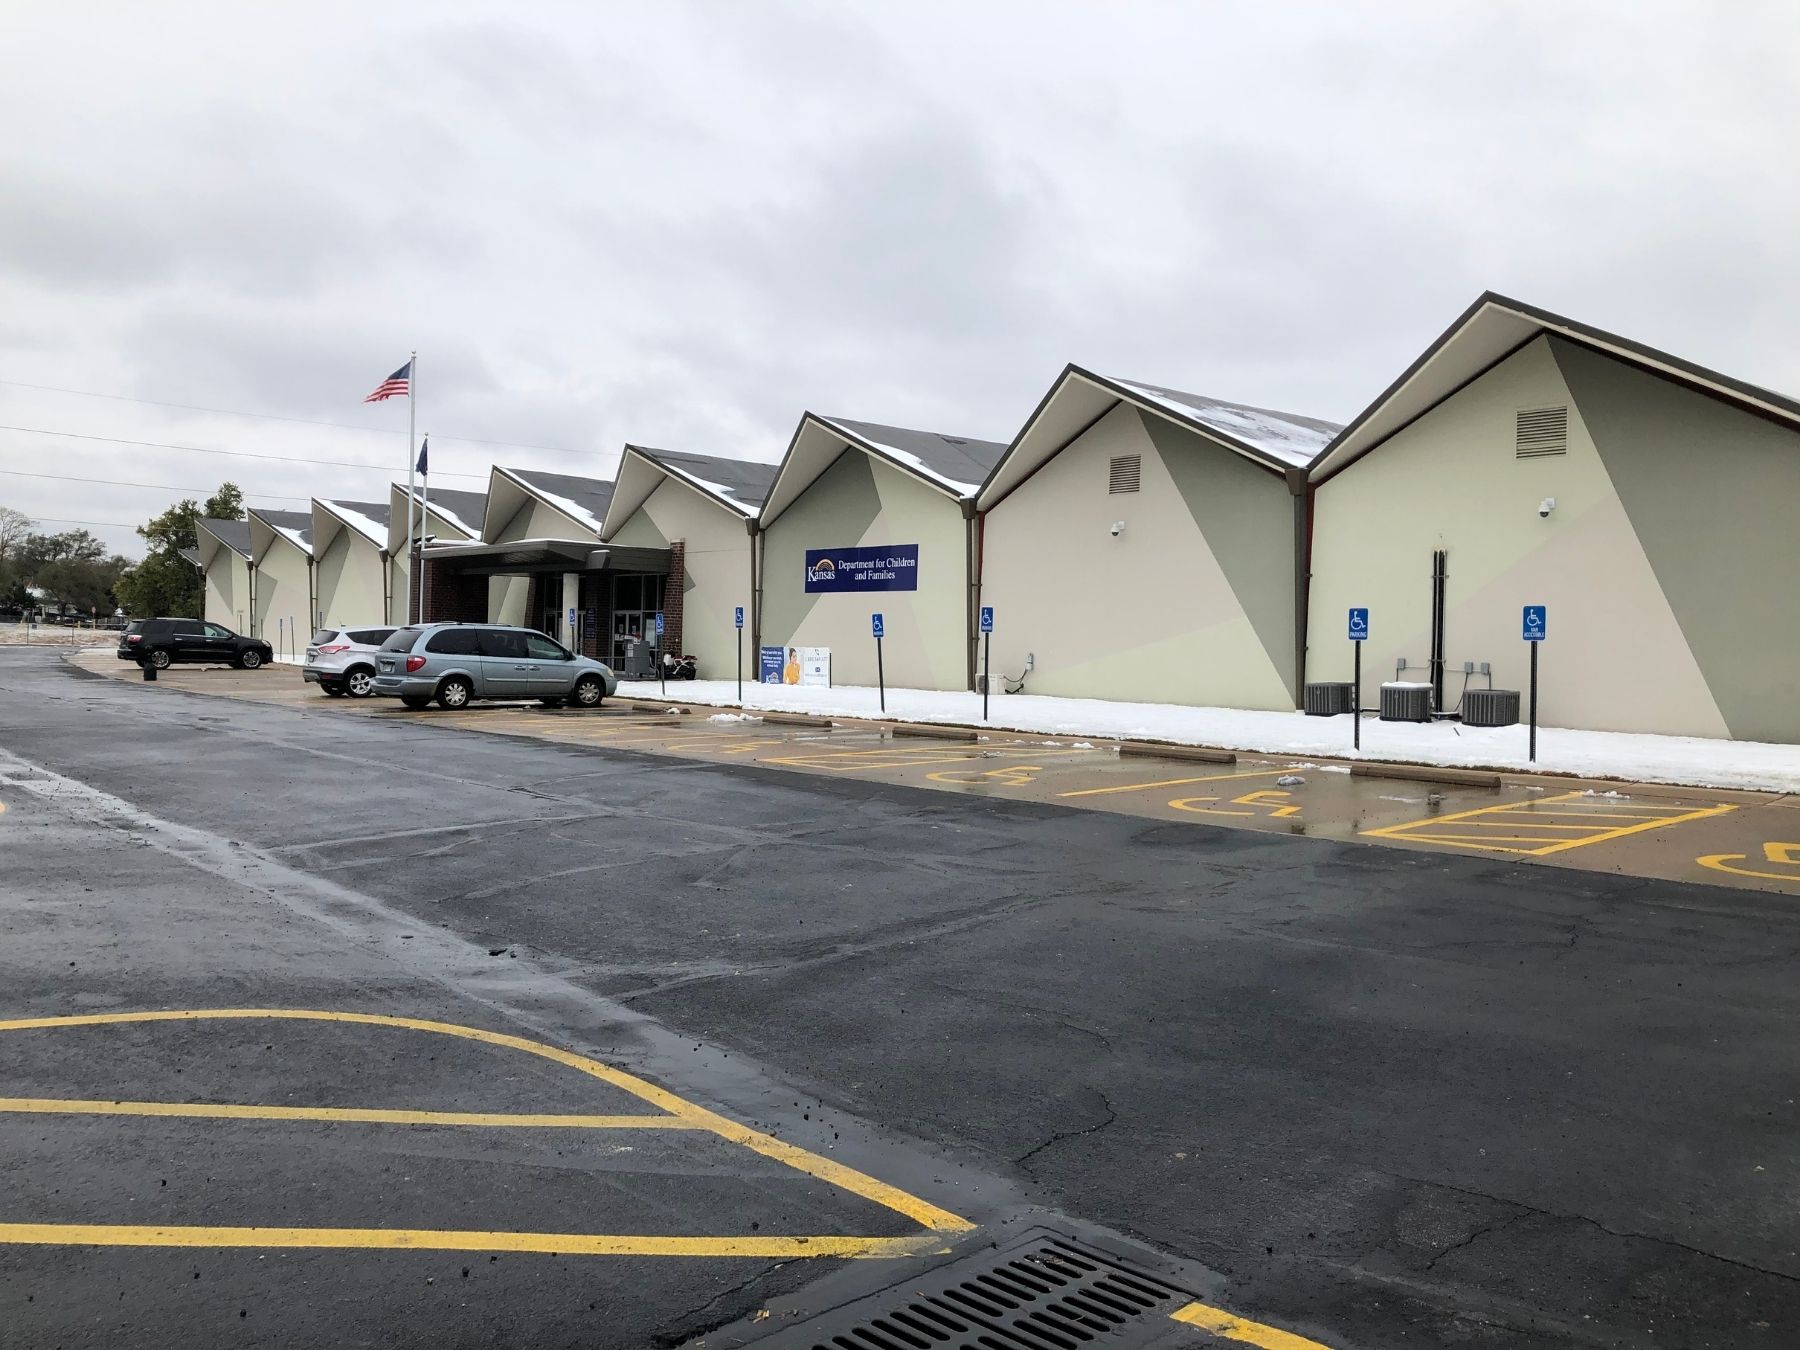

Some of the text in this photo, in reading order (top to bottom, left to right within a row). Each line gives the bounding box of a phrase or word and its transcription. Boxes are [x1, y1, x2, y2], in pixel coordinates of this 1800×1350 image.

[838, 557, 915, 571] Department for Children
[807, 566, 836, 581] Kansas
[854, 569, 895, 580] and Families
